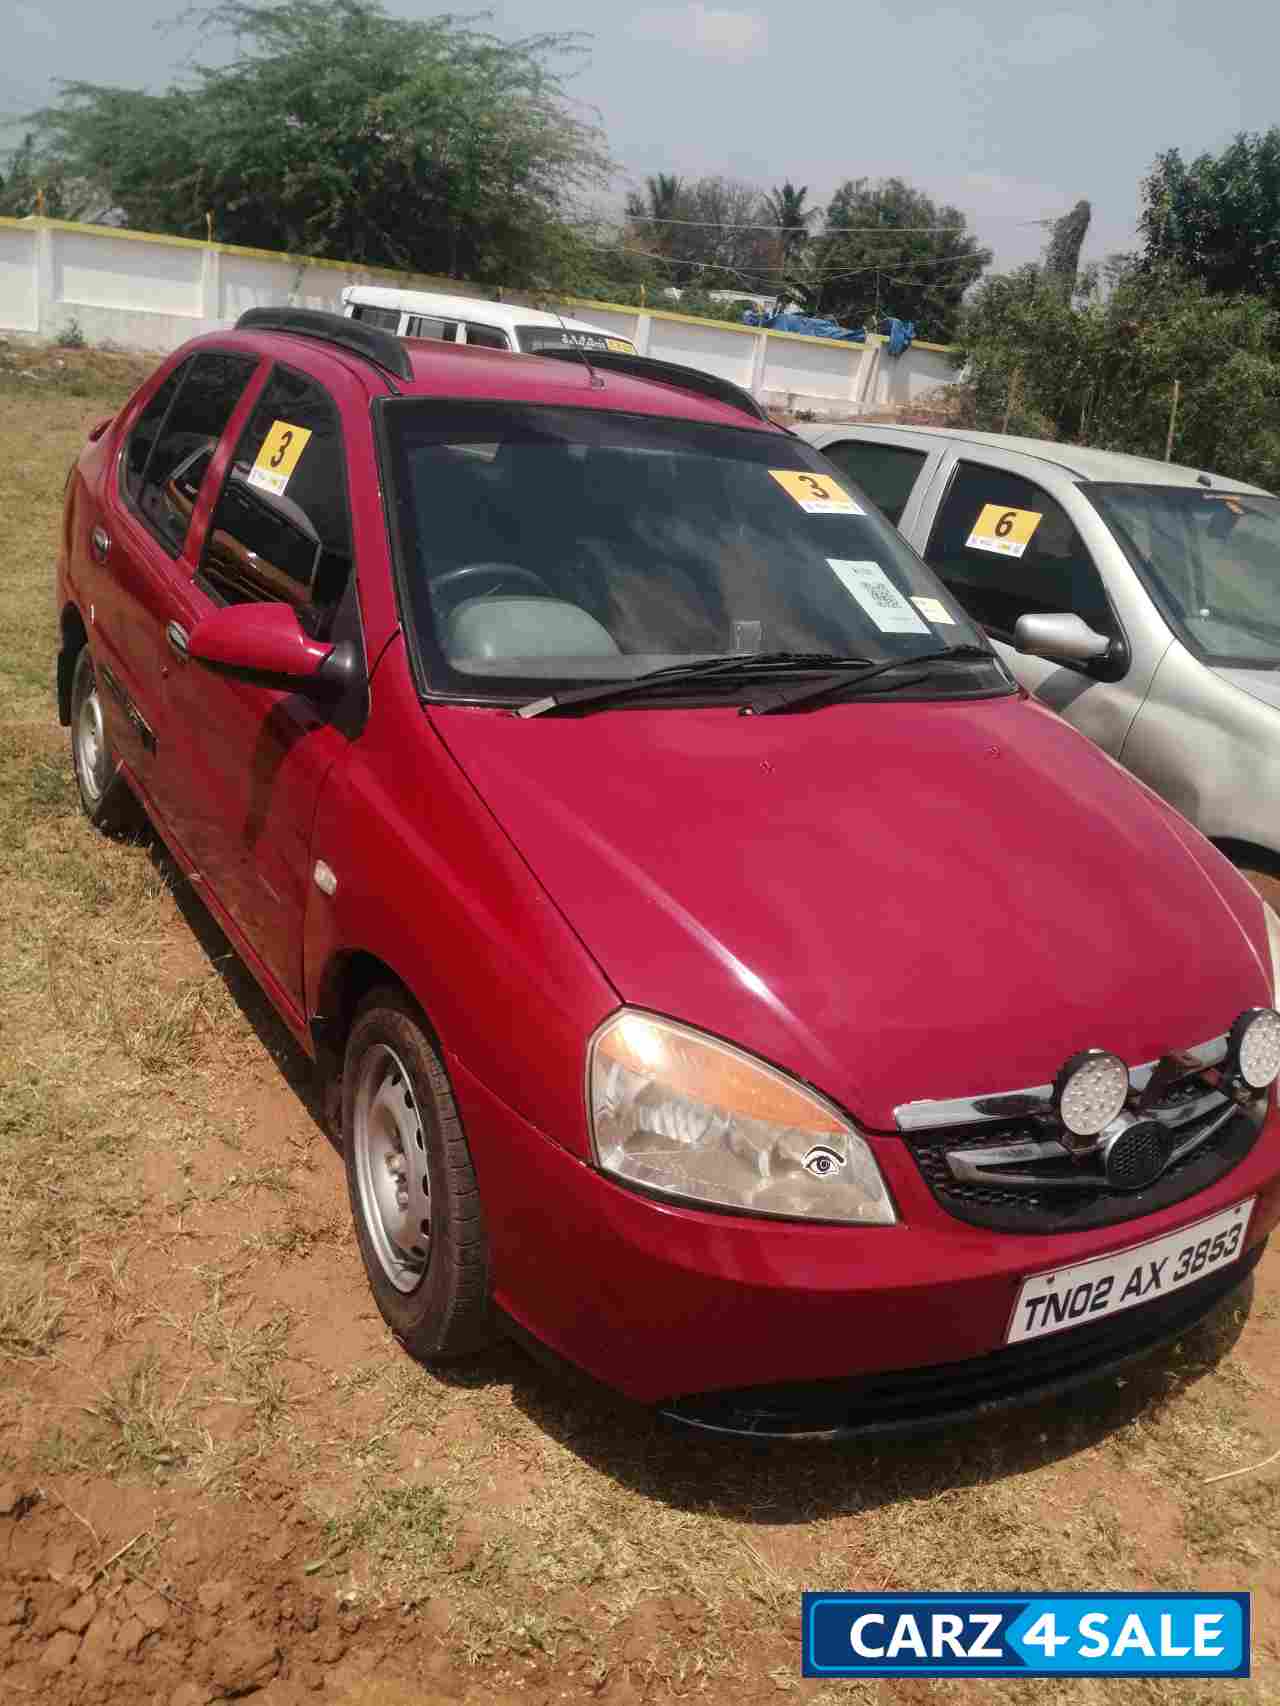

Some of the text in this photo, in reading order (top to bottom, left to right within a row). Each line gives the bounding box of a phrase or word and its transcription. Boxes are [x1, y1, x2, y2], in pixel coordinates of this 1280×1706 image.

[270, 431, 293, 468] 3
[798, 474, 830, 499] 3
[995, 511, 1017, 537] 6
[1024, 1222, 1243, 1331] TN02 AX 3853
